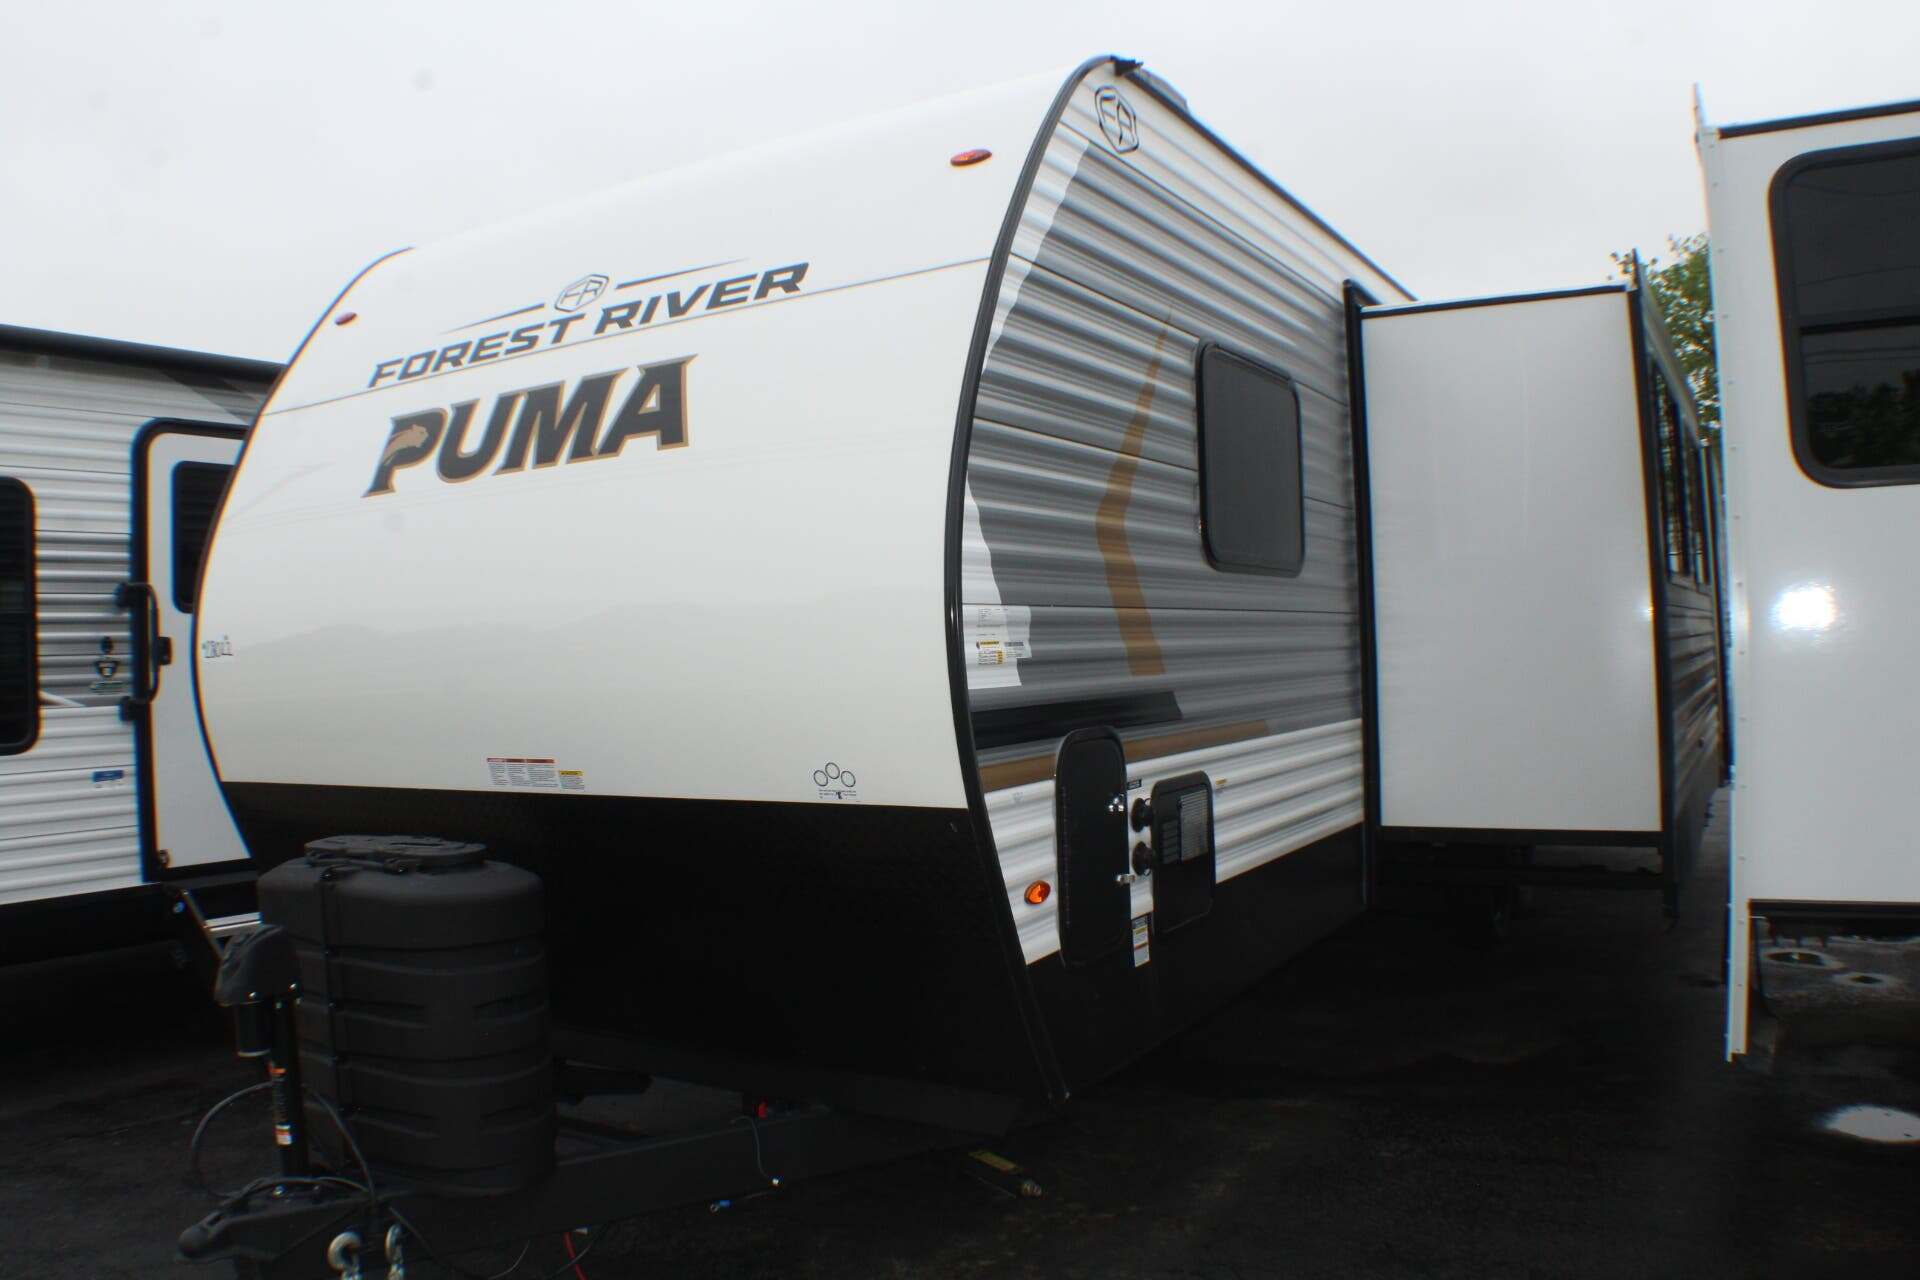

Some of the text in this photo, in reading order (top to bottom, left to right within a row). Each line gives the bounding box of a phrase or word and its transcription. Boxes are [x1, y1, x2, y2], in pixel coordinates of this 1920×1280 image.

[368, 261, 809, 388] FOREST RIVER
[360, 353, 699, 499] PUMA
